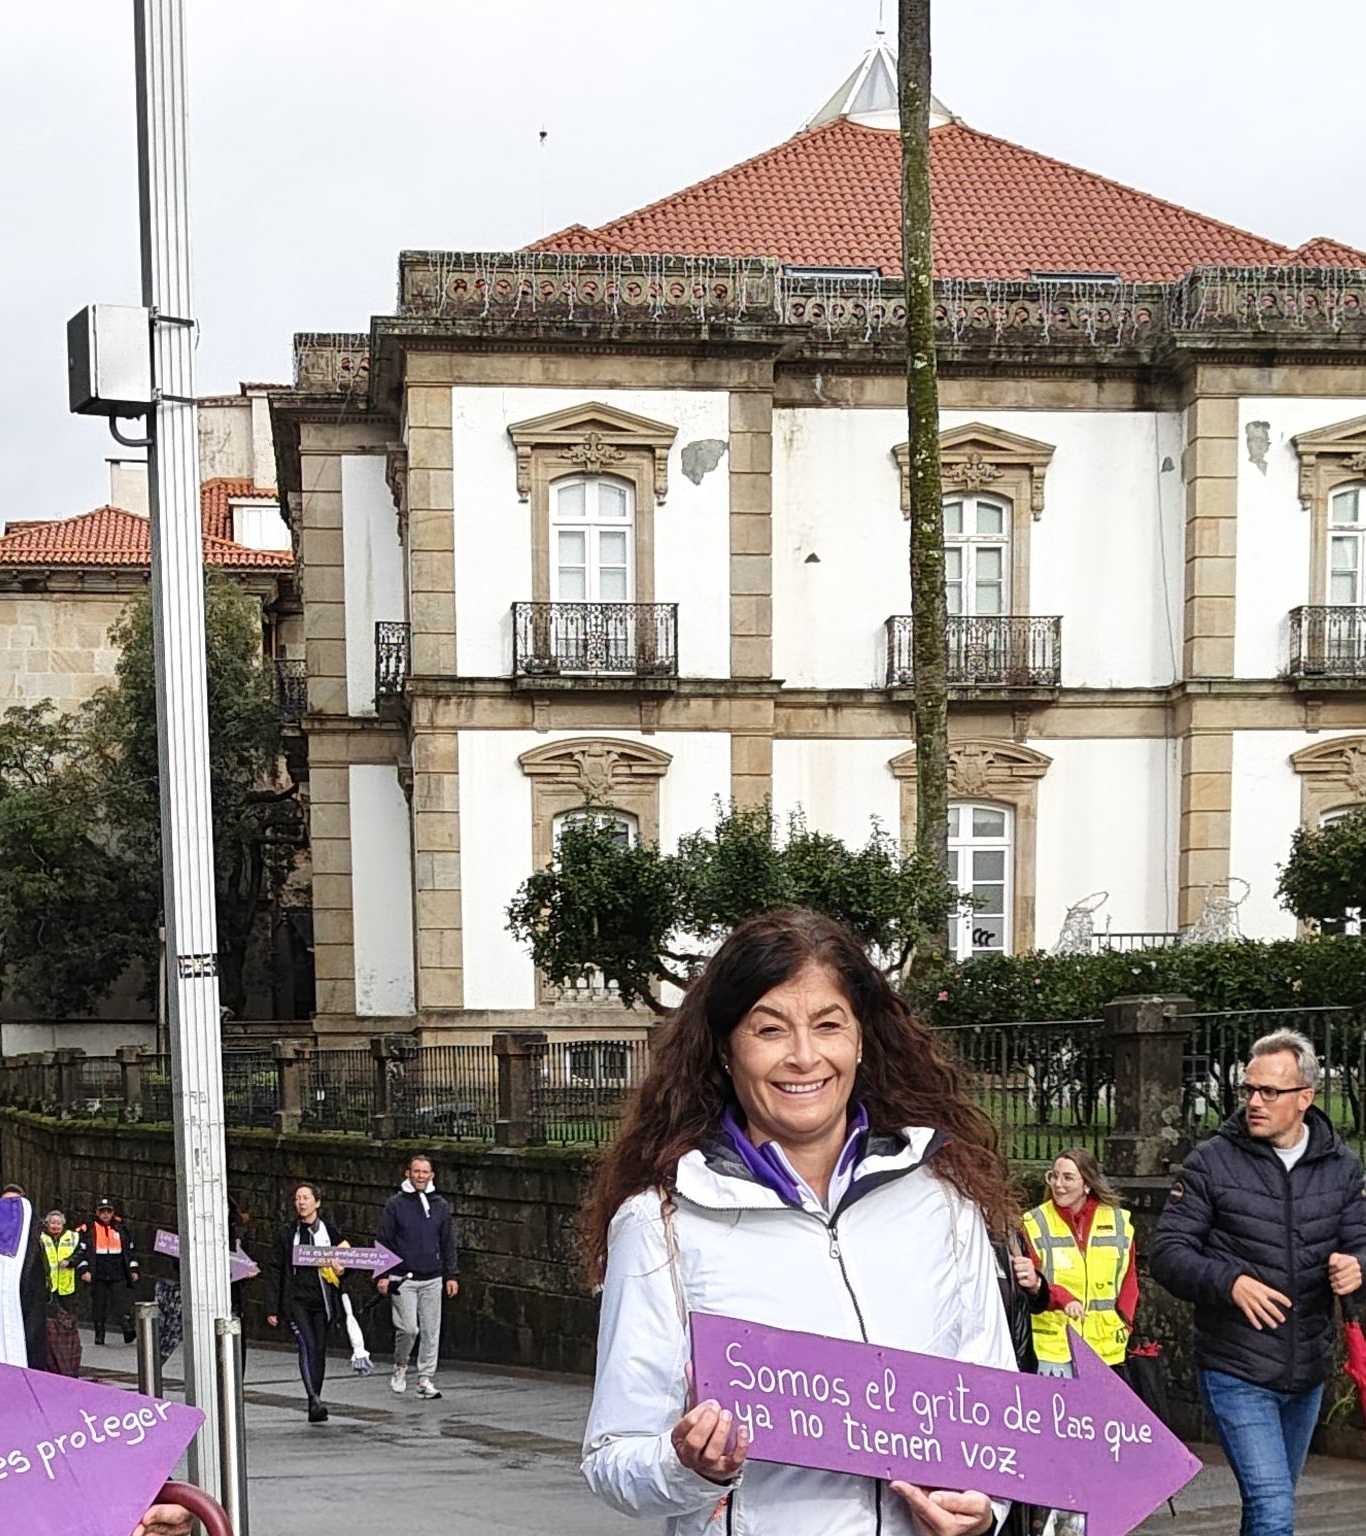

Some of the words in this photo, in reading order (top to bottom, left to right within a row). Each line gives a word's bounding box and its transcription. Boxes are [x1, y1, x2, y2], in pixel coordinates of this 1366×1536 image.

[35, 1400, 173, 1480] proteger
[725, 1342, 851, 1407] Somos
[865, 1368, 896, 1412] el
[912, 1373, 990, 1435] grito
[1003, 1385, 1041, 1434] de
[1052, 1393, 1095, 1440] las
[1104, 1420, 1153, 1462] que
[735, 1400, 774, 1444] ya
[789, 1407, 824, 1439] no
[843, 1411, 943, 1463] tienen
[960, 1441, 1025, 1479] voz.
